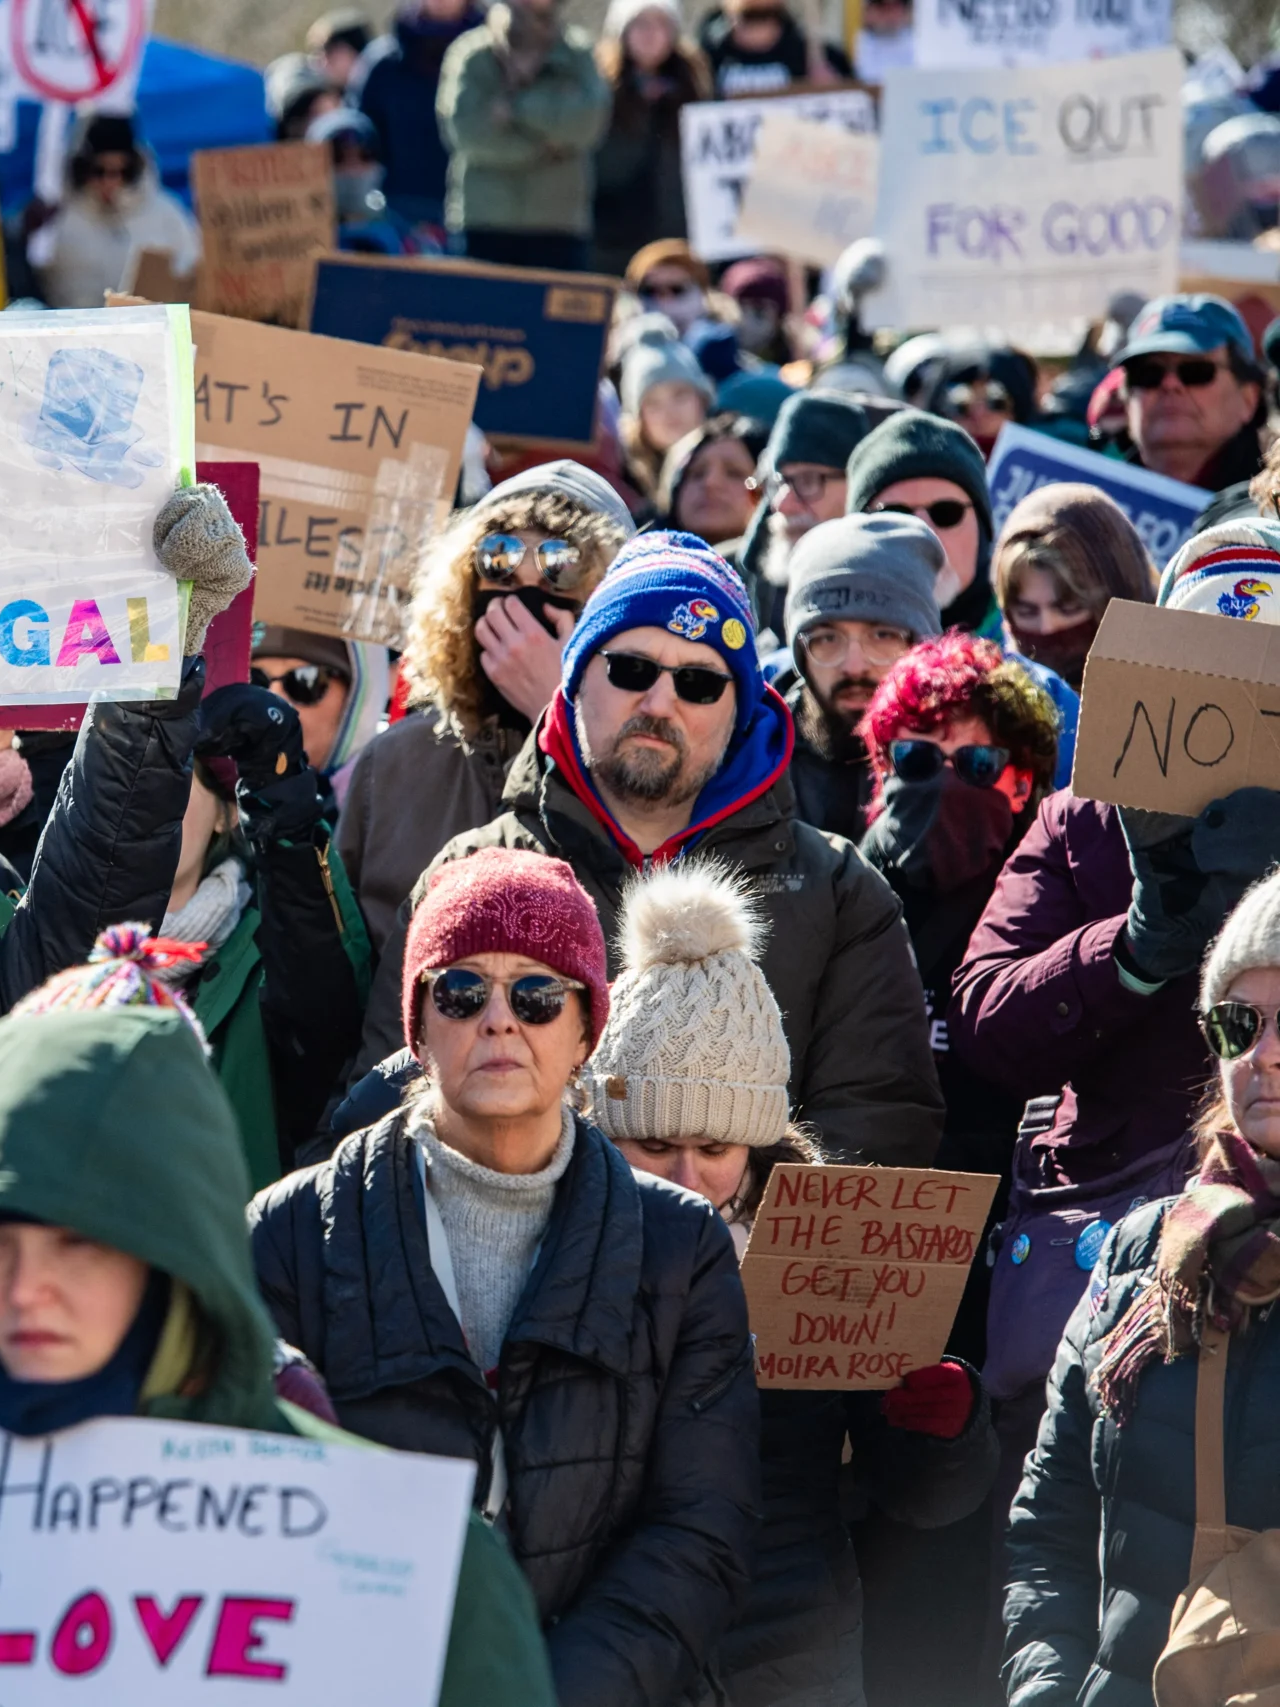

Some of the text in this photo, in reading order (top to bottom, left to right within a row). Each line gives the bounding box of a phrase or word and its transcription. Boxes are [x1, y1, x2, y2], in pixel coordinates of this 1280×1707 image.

[918, 96, 1040, 157] ICE
[1058, 93, 1167, 156] OUT
[924, 196, 1176, 265] FOR GOOD
[195, 373, 410, 449] AT'S IN
[257, 500, 409, 577] ILES?
[773, 1171, 971, 1214] NEVER LET
[766, 1214, 844, 1250] THE
[781, 1261, 926, 1309] GET YOU
[788, 1301, 898, 1347] DOWN!
[755, 1352, 915, 1381] MOIRA ROSE
